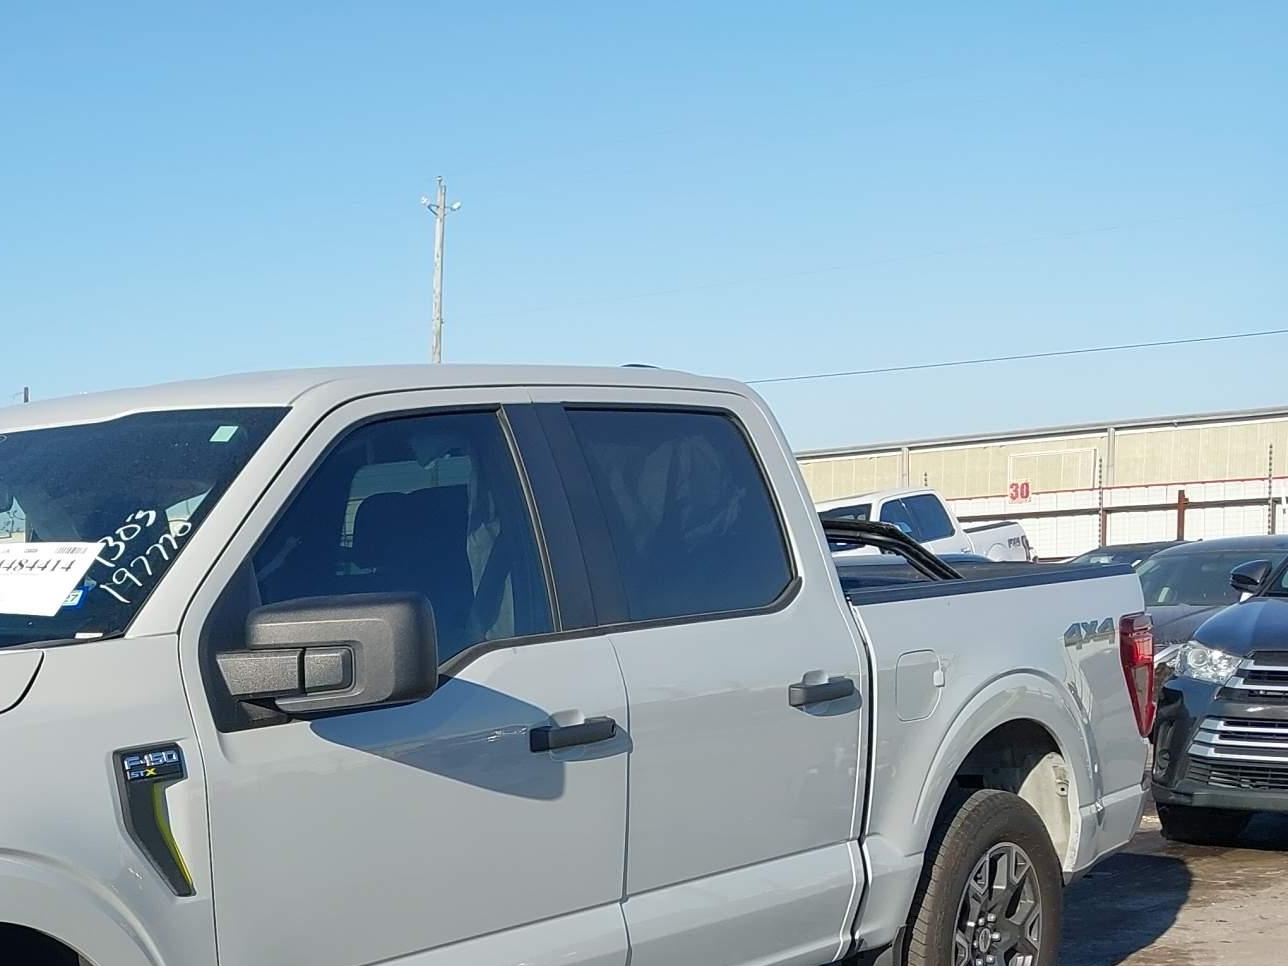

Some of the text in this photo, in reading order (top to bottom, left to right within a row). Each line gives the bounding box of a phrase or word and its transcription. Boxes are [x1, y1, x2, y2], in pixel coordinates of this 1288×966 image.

[1009, 482, 1030, 501] 30
[124, 750, 179, 770] F-150
[130, 768, 157, 779] STX
